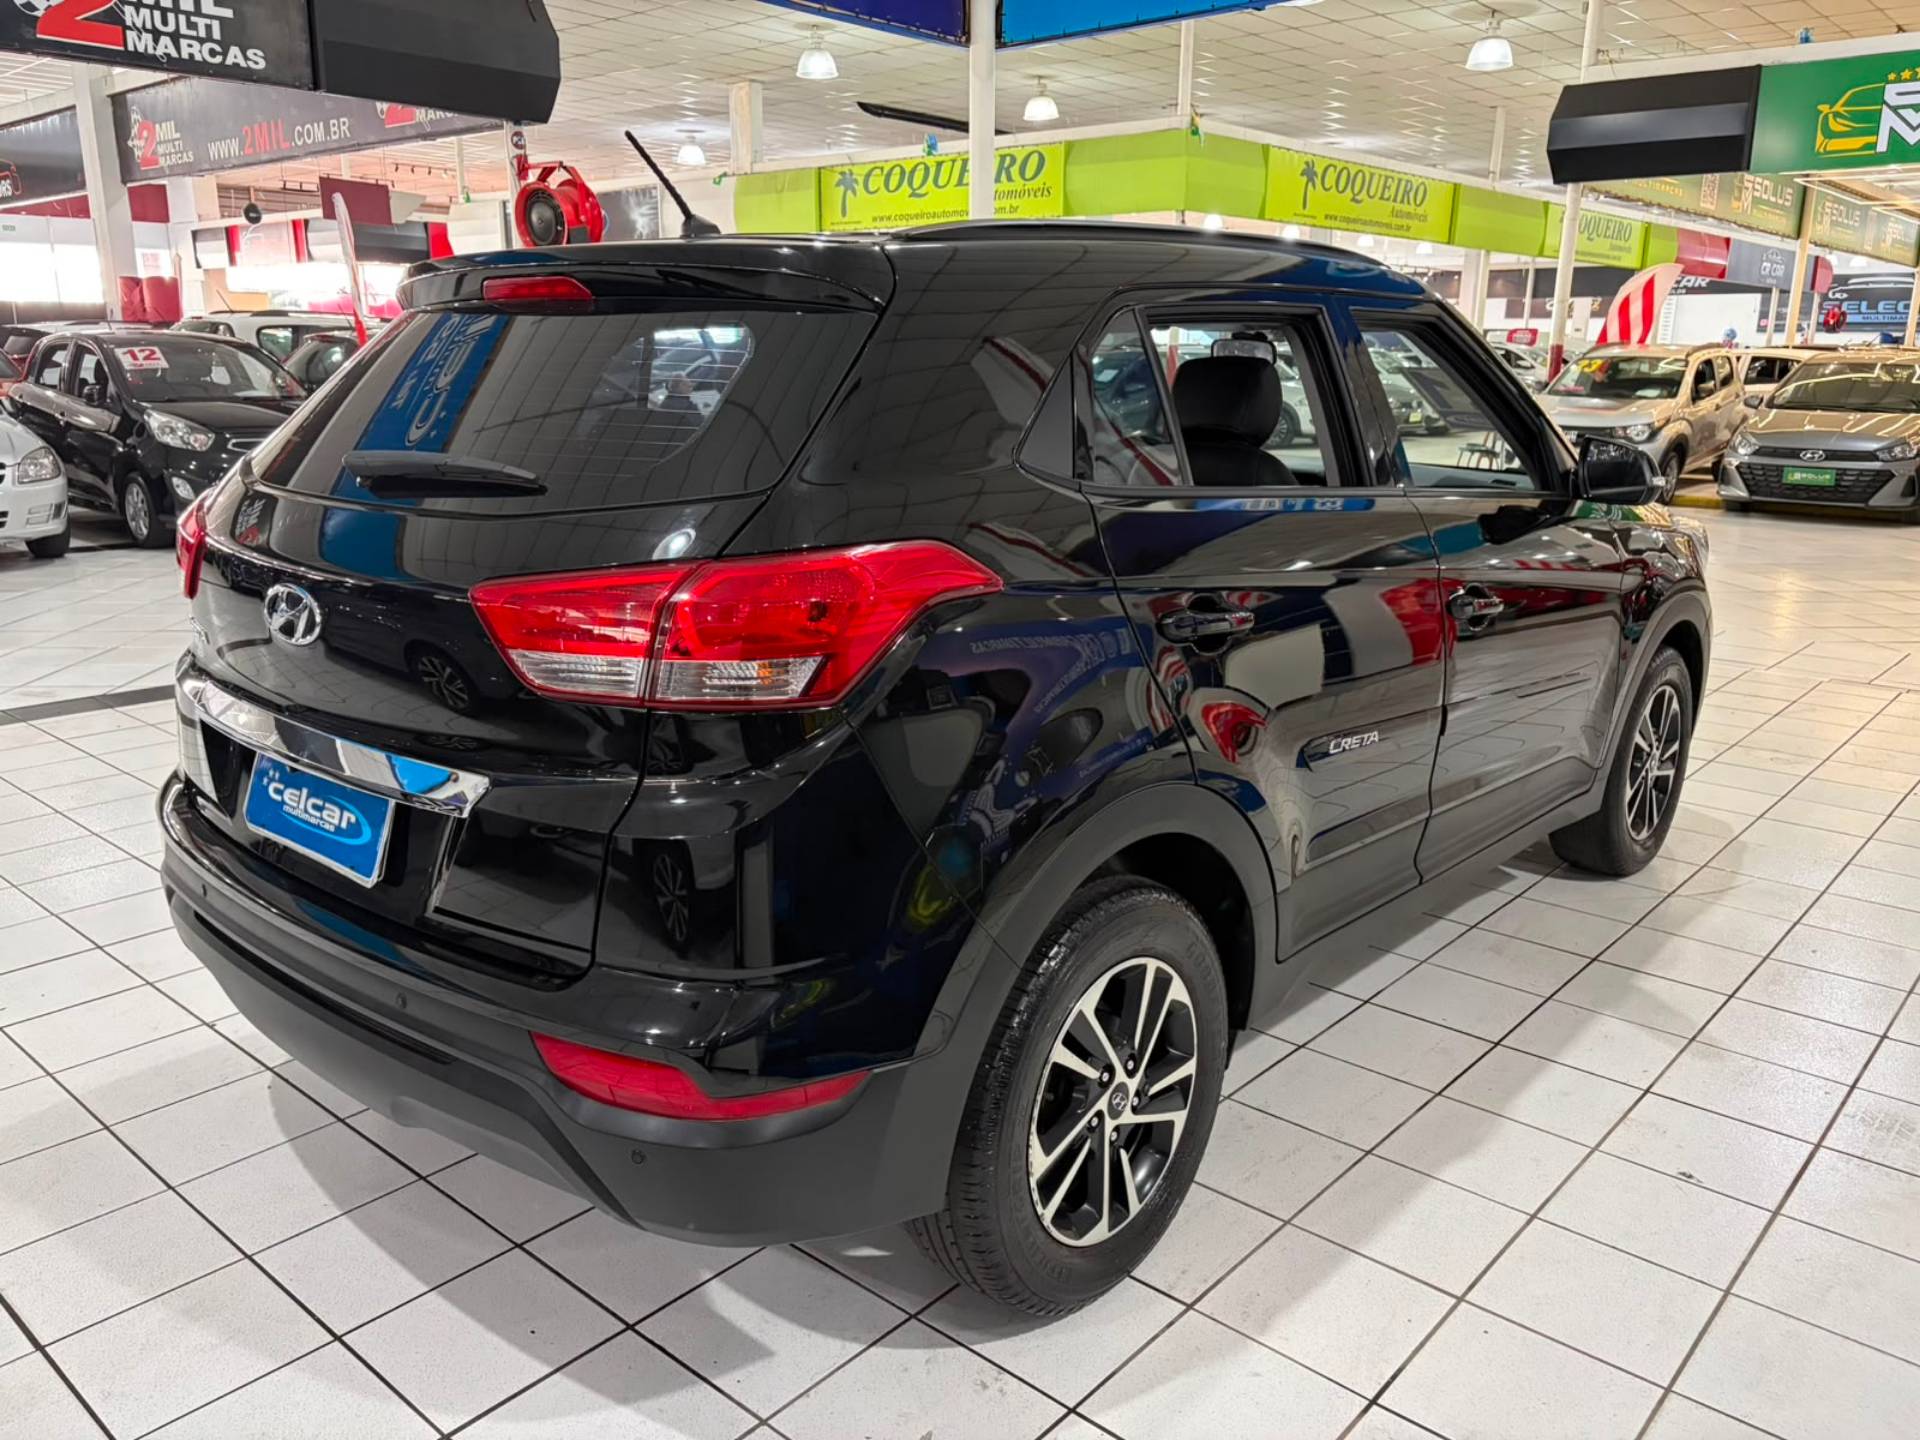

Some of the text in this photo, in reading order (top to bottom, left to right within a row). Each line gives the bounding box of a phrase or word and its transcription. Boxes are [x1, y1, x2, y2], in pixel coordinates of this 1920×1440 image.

[124, 5, 222, 41] MULTI
[126, 31, 267, 70] MARCAS
[137, 120, 160, 170] 2
[156, 120, 181, 141] MIL
[156, 140, 184, 153] MULTI
[158, 151, 194, 168] MARCAS
[862, 150, 1046, 198] COQUERO
[1321, 163, 1428, 208] COQUEIRO
[993, 182, 1052, 200] tomóveis
[1753, 176, 1794, 207] SOLUS
[1578, 212, 1633, 242] OQUEIRO
[1821, 300, 1911, 313] SELEC
[122, 348, 161, 362] 12
[1329, 730, 1379, 754] CRETA
[268, 782, 356, 830] celcar
[282, 804, 336, 833] multimarcas
